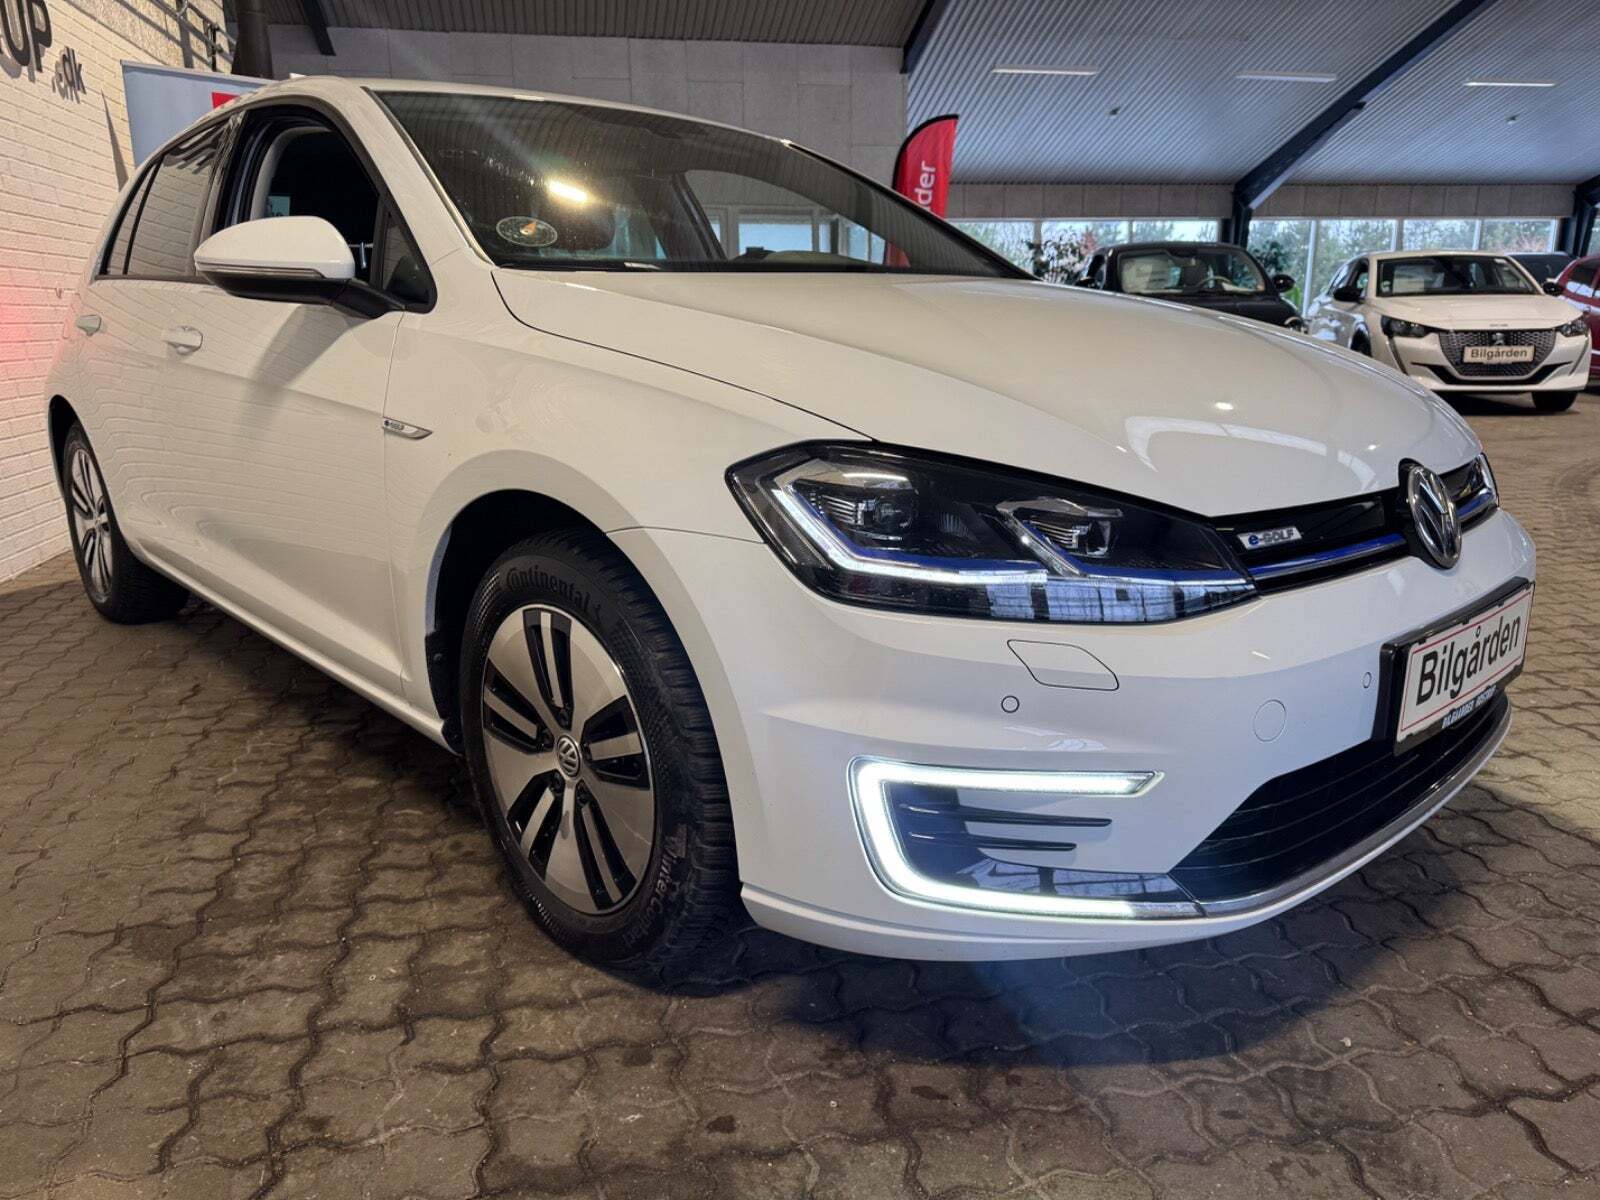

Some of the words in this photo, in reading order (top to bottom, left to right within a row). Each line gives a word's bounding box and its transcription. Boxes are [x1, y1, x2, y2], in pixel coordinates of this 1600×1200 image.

[0, 0, 52, 73] UP
[914, 160, 936, 210] der
[1470, 348, 1528, 360] Bilgården
[506, 564, 591, 613] Continental
[1416, 615, 1521, 706] Bilgården
